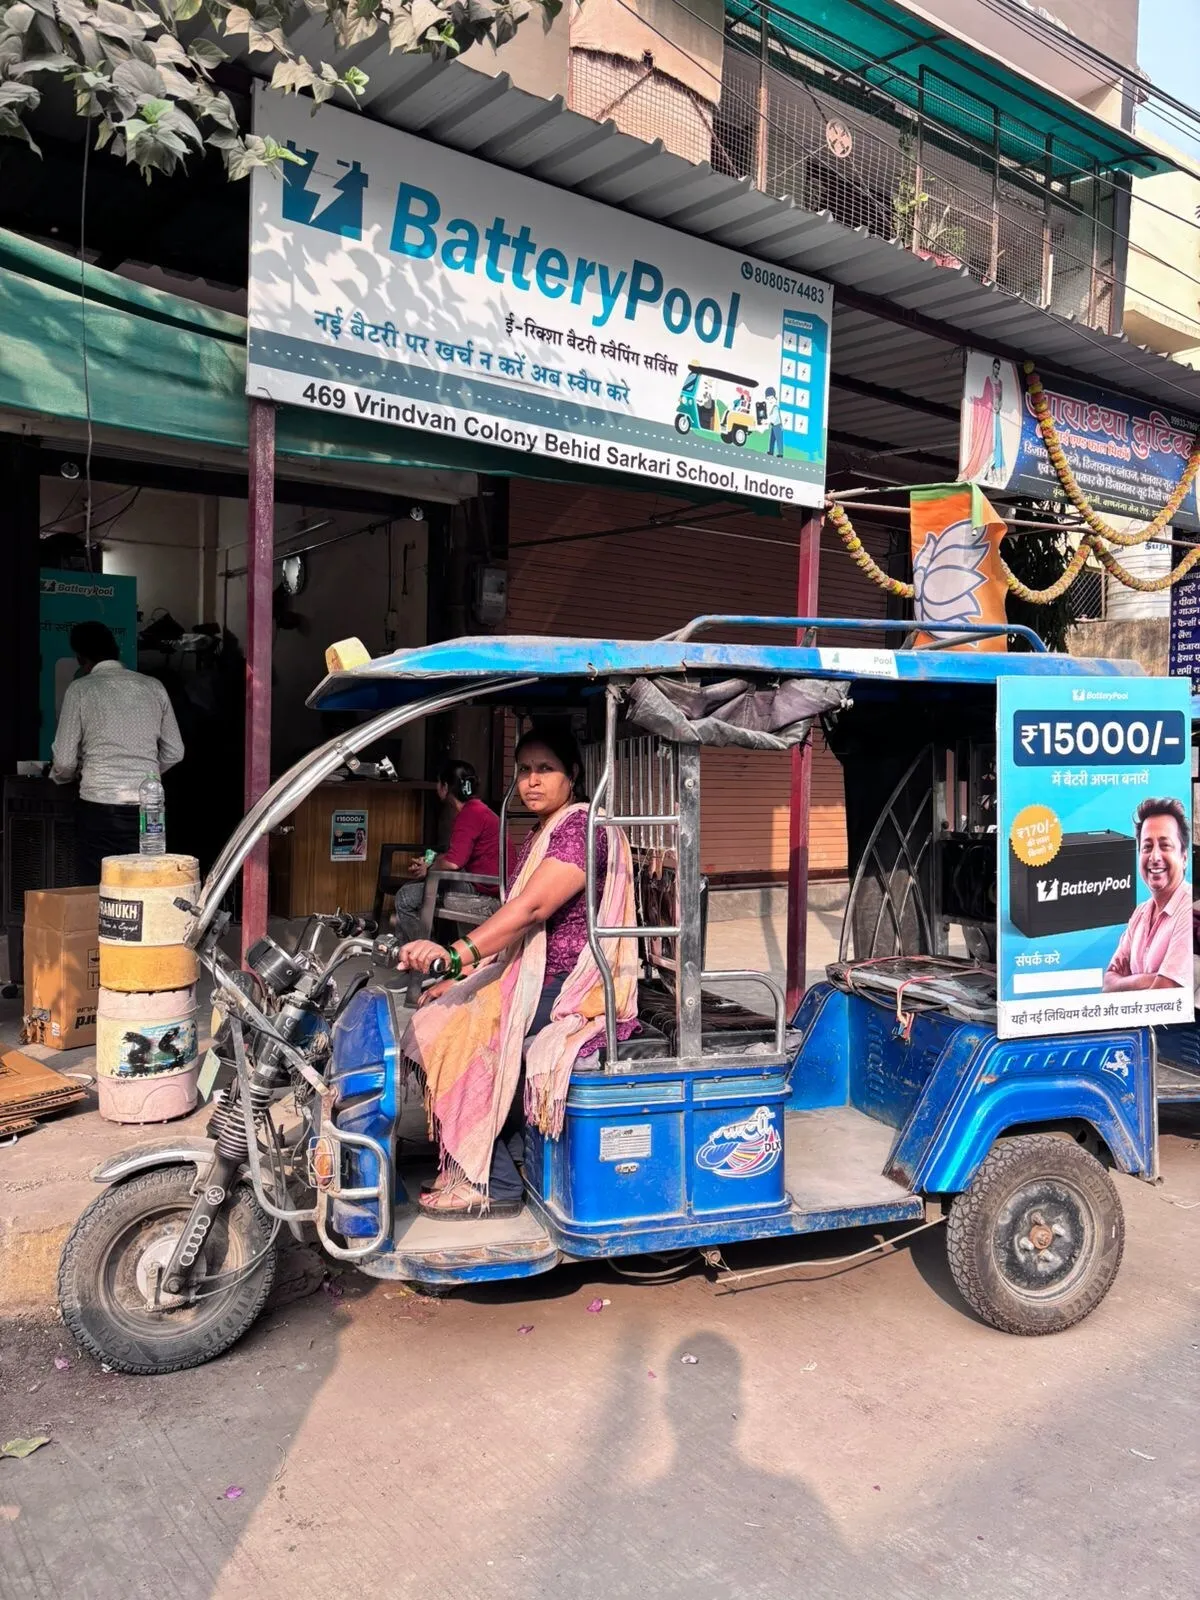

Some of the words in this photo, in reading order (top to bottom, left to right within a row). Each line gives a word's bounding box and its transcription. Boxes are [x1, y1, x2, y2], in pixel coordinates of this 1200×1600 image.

[390, 181, 741, 349] BatteryPool
[754, 267, 824, 304] 8080574483
[314, 307, 343, 340] नई
[350, 312, 399, 349] बैटरी
[405, 332, 429, 357] पर
[435, 341, 473, 367] खर्च
[479, 351, 493, 371] न
[498, 352, 526, 379] करें
[530, 361, 562, 388] अब
[567, 369, 602, 396] स्वैप
[567, 328, 596, 354] बैटरी
[302, 382, 346, 410] 469
[353, 391, 457, 433] Vrindvan
[464, 415, 538, 453] Colony
[544, 433, 600, 463] Behid
[606, 446, 670, 477] Sarkari
[675, 461, 740, 494] School,
[743, 475, 794, 501] Indore
[1021, 720, 1180, 756] ₹15000/-
[1063, 769, 1088, 786] बैटरी
[1090, 773, 1118, 785] अपना
[1060, 874, 1131, 897] BatteryPool
[1014, 950, 1043, 967] संपर्क
[1081, 1004, 1101, 1018] बैटरी
[1103, 1003, 1119, 1016] और
